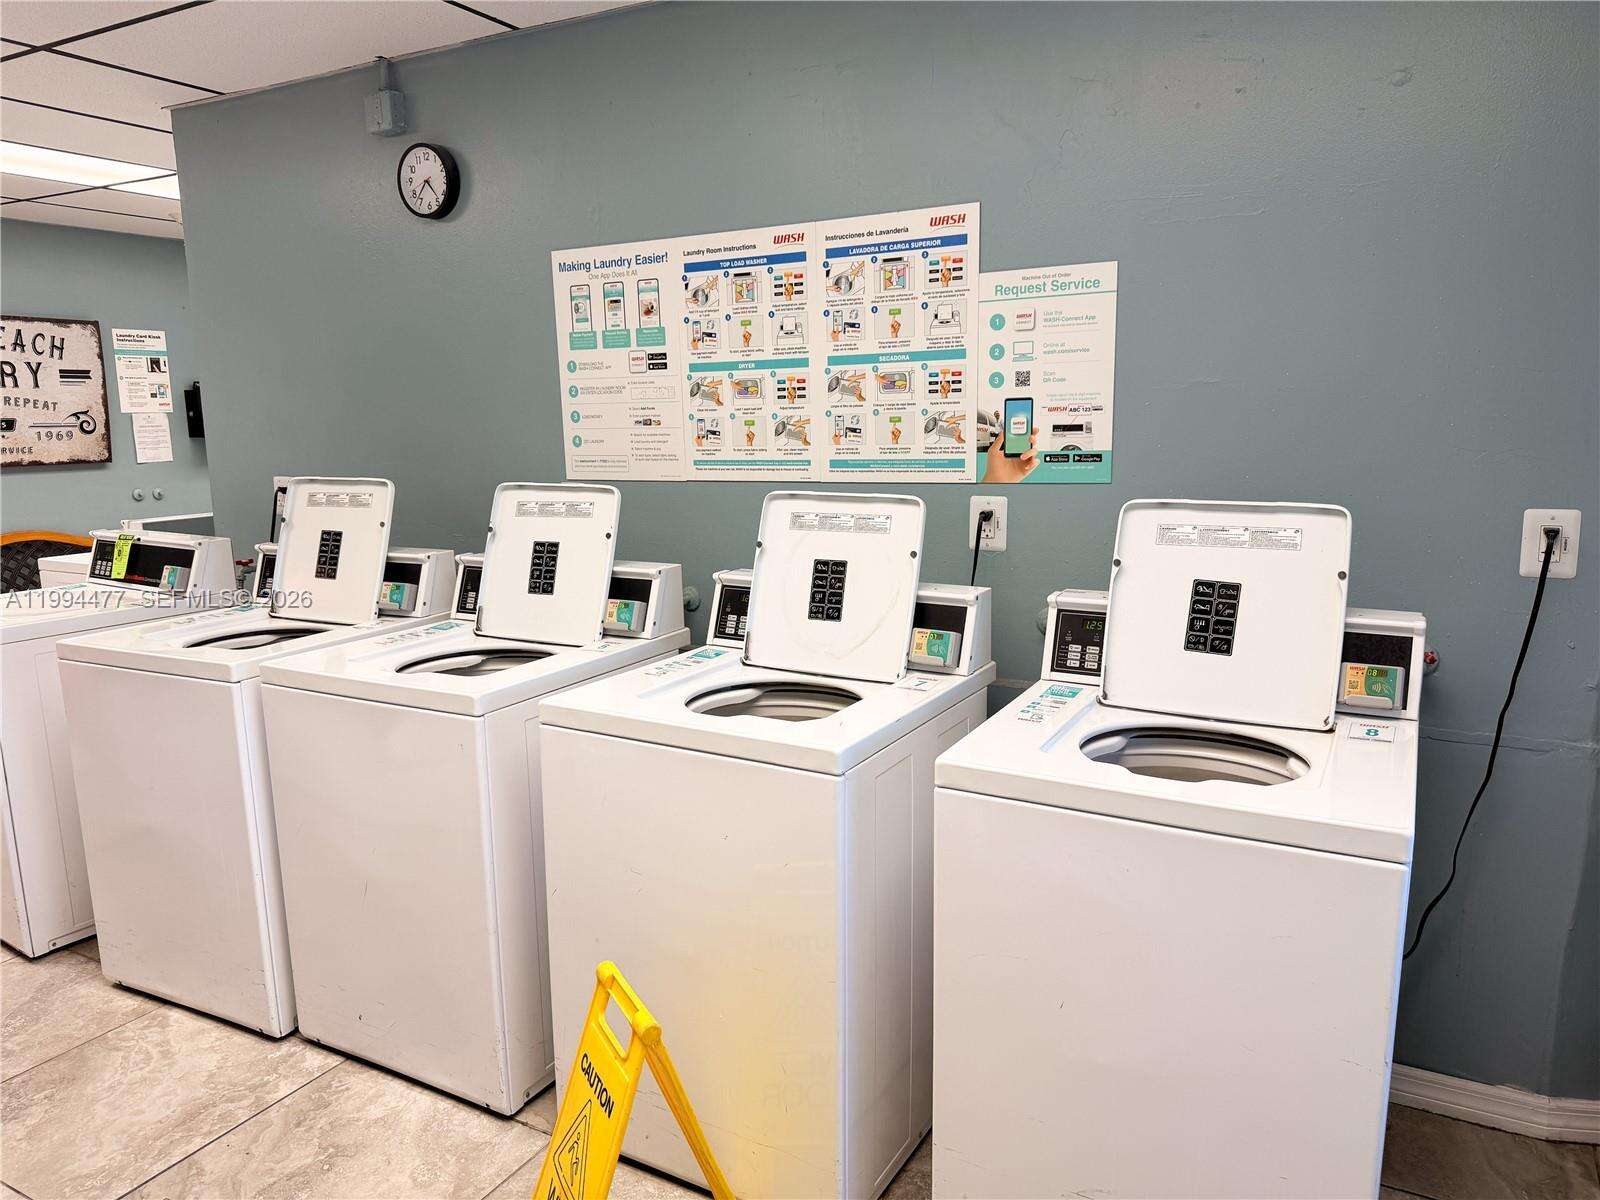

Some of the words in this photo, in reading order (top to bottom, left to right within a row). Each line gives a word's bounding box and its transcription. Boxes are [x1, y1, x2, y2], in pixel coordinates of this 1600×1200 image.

[415, 155, 421, 165] 11
[423, 152, 429, 160] 12
[408, 165, 415, 174] 10
[409, 177, 413, 186] 9
[412, 190, 417, 198] 8
[419, 198, 423, 206] 7
[427, 201, 432, 210] 6
[436, 198, 440, 206] 5
[929, 213, 966, 227] WASH
[773, 232, 805, 245] WASH
[825, 232, 865, 241] Instrucciones
[706, 246, 722, 254] Room
[723, 244, 756, 252] Instructions
[849, 246, 879, 255] LAVADORA
[889, 243, 910, 251] CARGA
[911, 240, 941, 248] SUPERIOR
[559, 261, 591, 273] Making
[594, 256, 632, 270] Laundry
[635, 251, 668, 265] Easier!
[600, 272, 610, 280] App
[612, 270, 625, 278] Does
[995, 282, 1047, 297] Request
[1051, 278, 1101, 292] Service
[3, 395, 59, 412] REPEAT
[34, 430, 74, 442] 1969
[1365, 728, 1379, 737] 8
[580, 1052, 615, 1119] CAUTION
